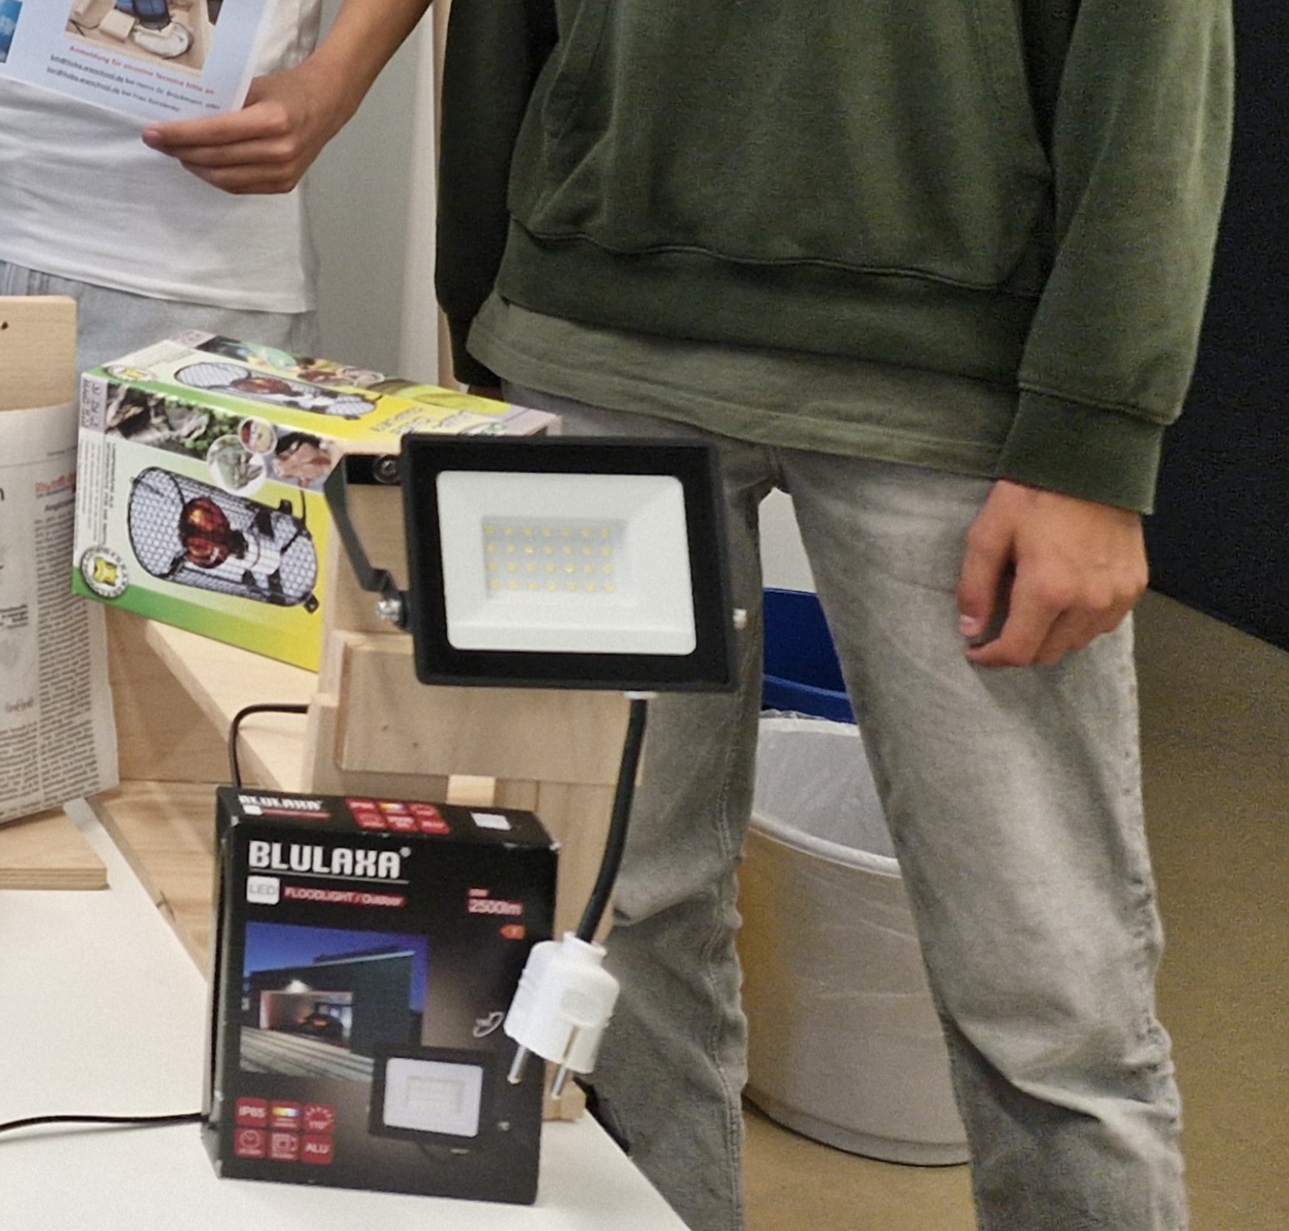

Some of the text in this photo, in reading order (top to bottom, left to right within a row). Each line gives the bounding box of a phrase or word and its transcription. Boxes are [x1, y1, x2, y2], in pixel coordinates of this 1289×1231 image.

[248, 839, 401, 879] BLULAXA
[248, 883, 277, 896] LED
[284, 886, 354, 902] FLOODLIGHT
